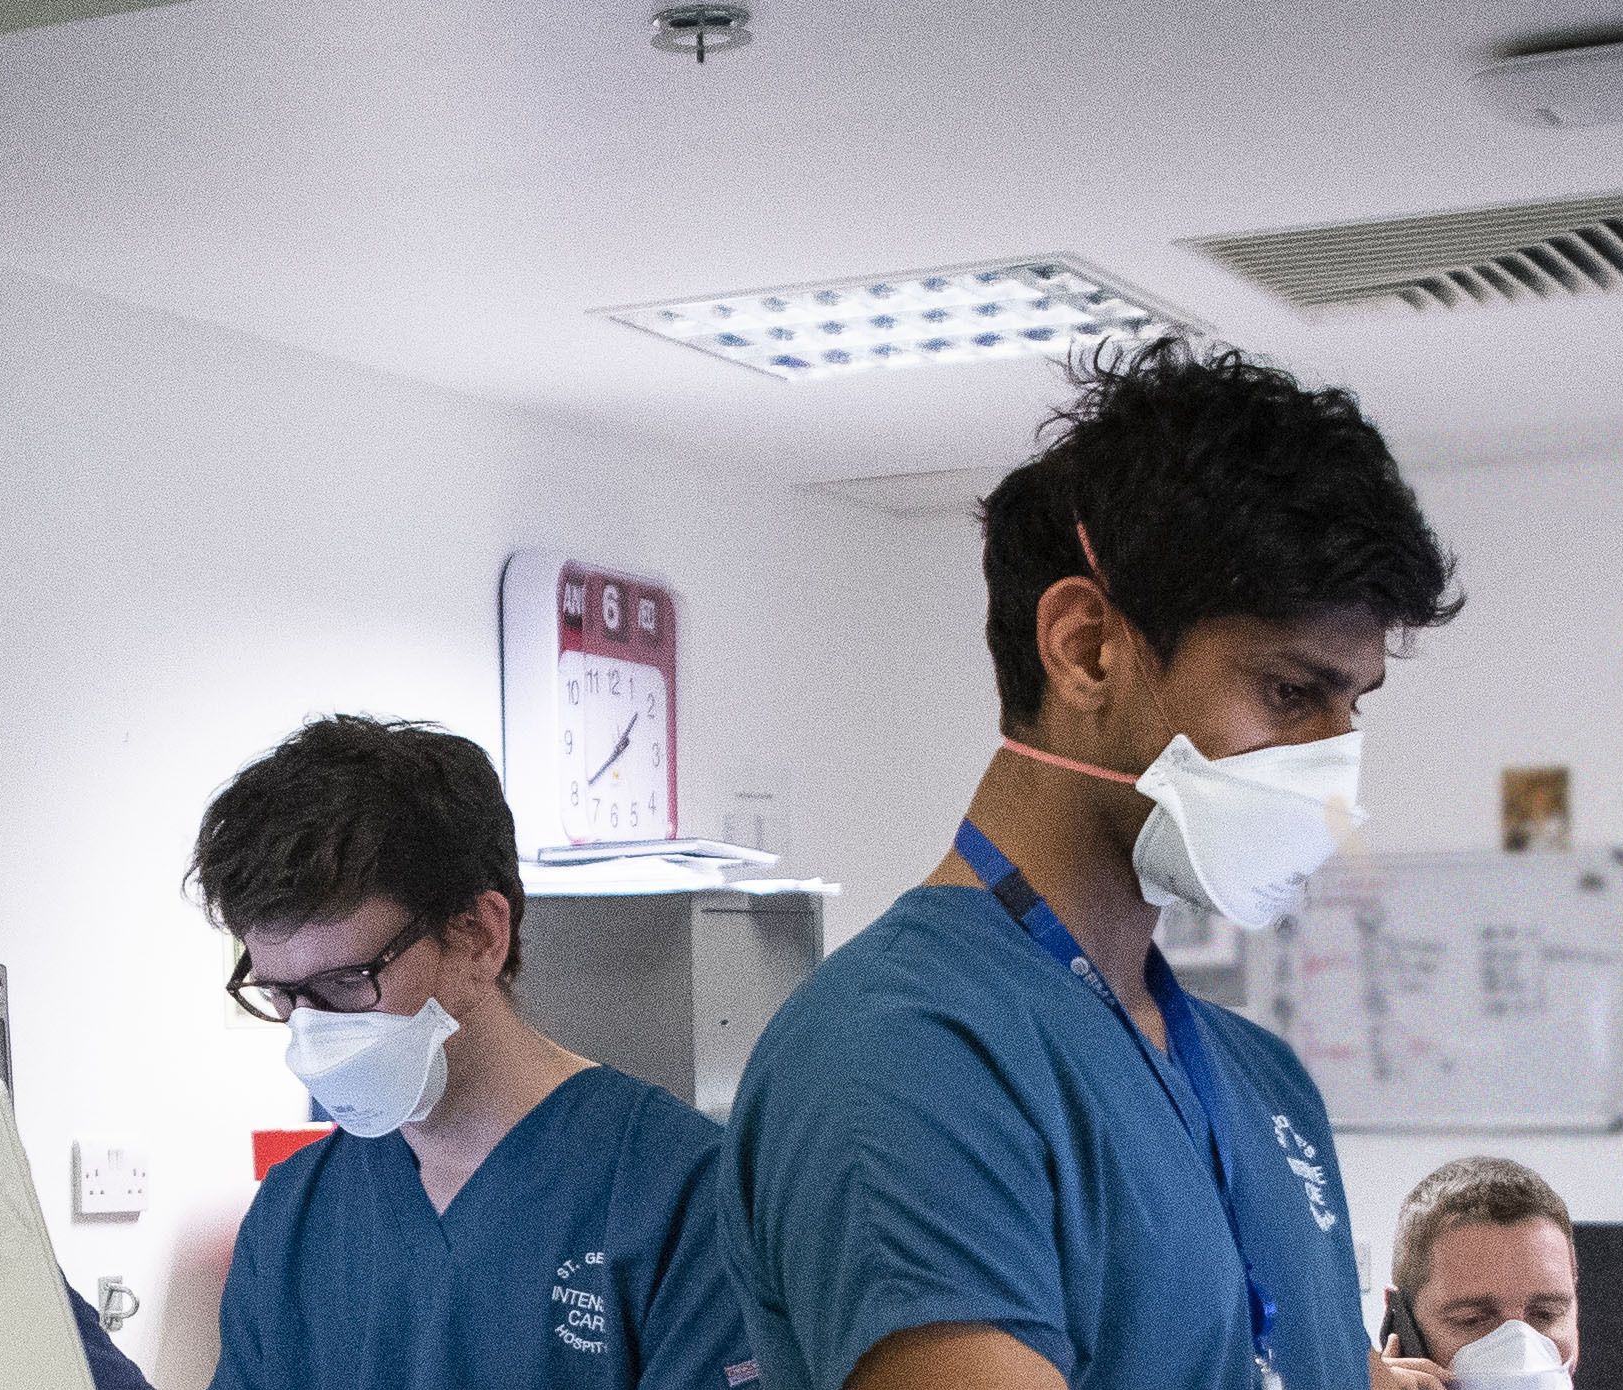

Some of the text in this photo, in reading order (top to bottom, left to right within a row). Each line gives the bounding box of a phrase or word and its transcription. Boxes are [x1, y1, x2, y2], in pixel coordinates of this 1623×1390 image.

[602, 584, 620, 630] 6
[566, 679, 656, 719] 10 2
[586, 669, 600, 694] 11
[607, 669, 621, 696] 12
[564, 729, 661, 768] 9 3
[570, 780, 657, 815] 8 4
[592, 798, 639, 829] 7 6 5
[556, 1259, 581, 1279] ST.
